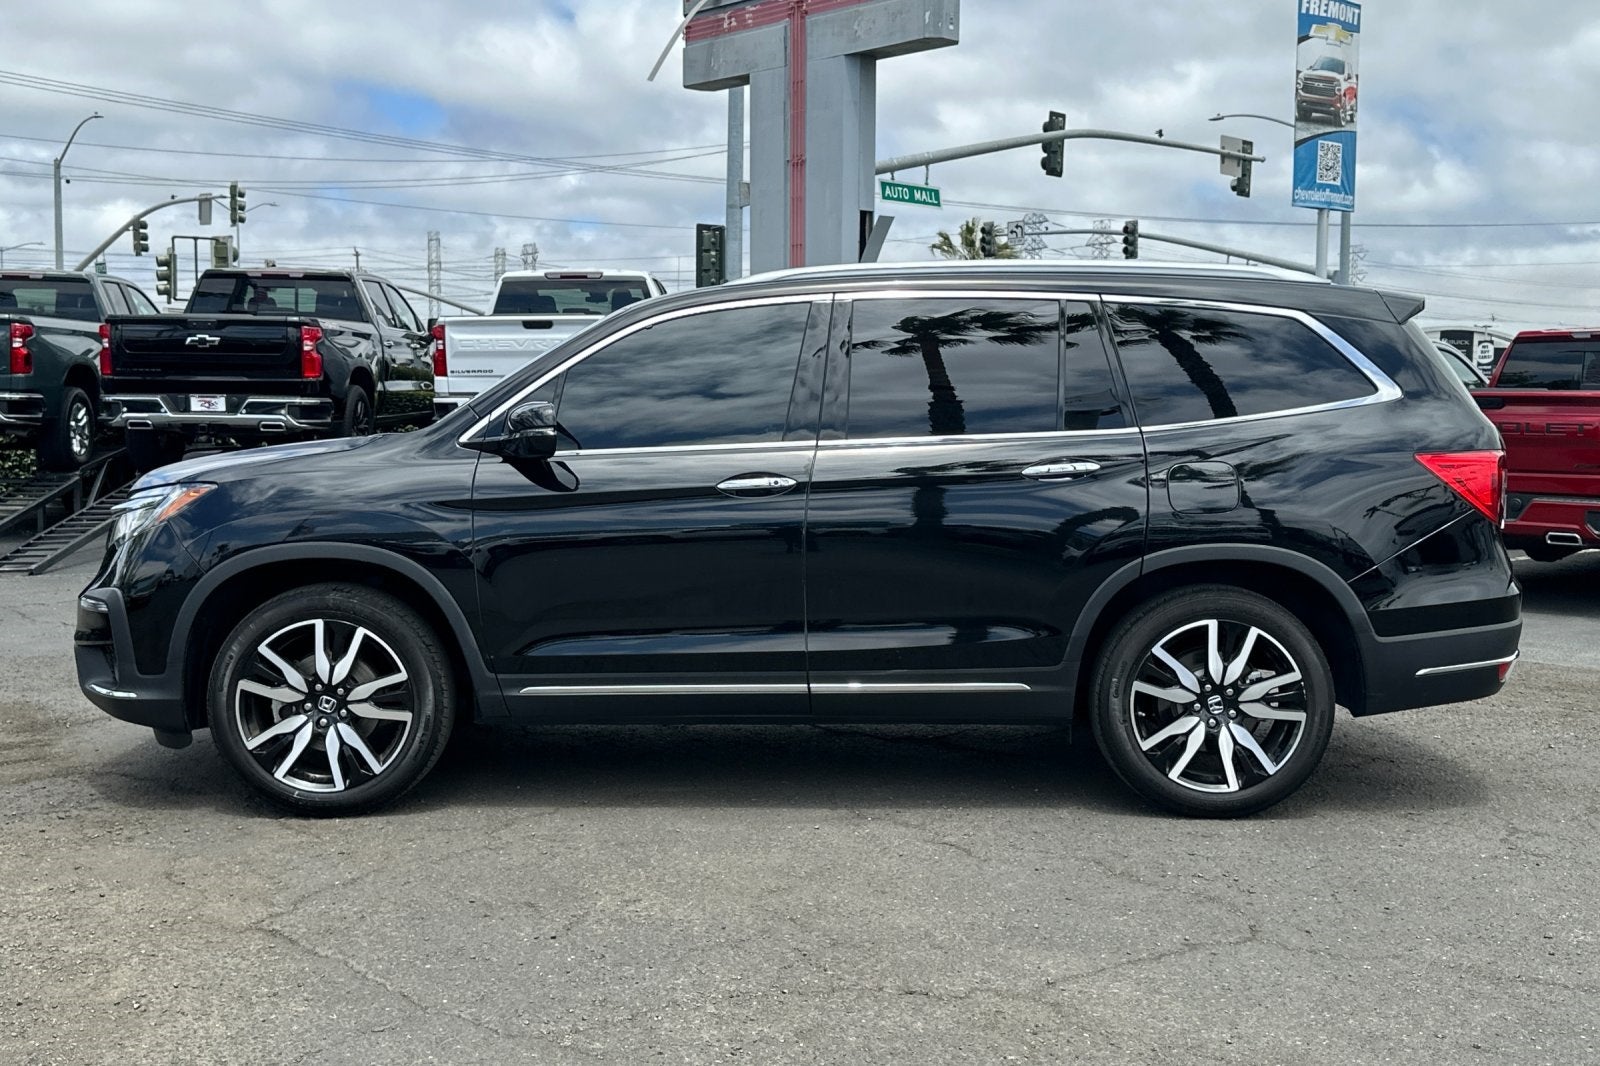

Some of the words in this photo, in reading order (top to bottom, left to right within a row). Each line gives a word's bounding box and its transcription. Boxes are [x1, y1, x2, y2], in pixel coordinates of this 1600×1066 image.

[1301, 0, 1360, 25] FREMONT
[885, 185, 909, 200] AUTO
[914, 189, 938, 204] MALL
